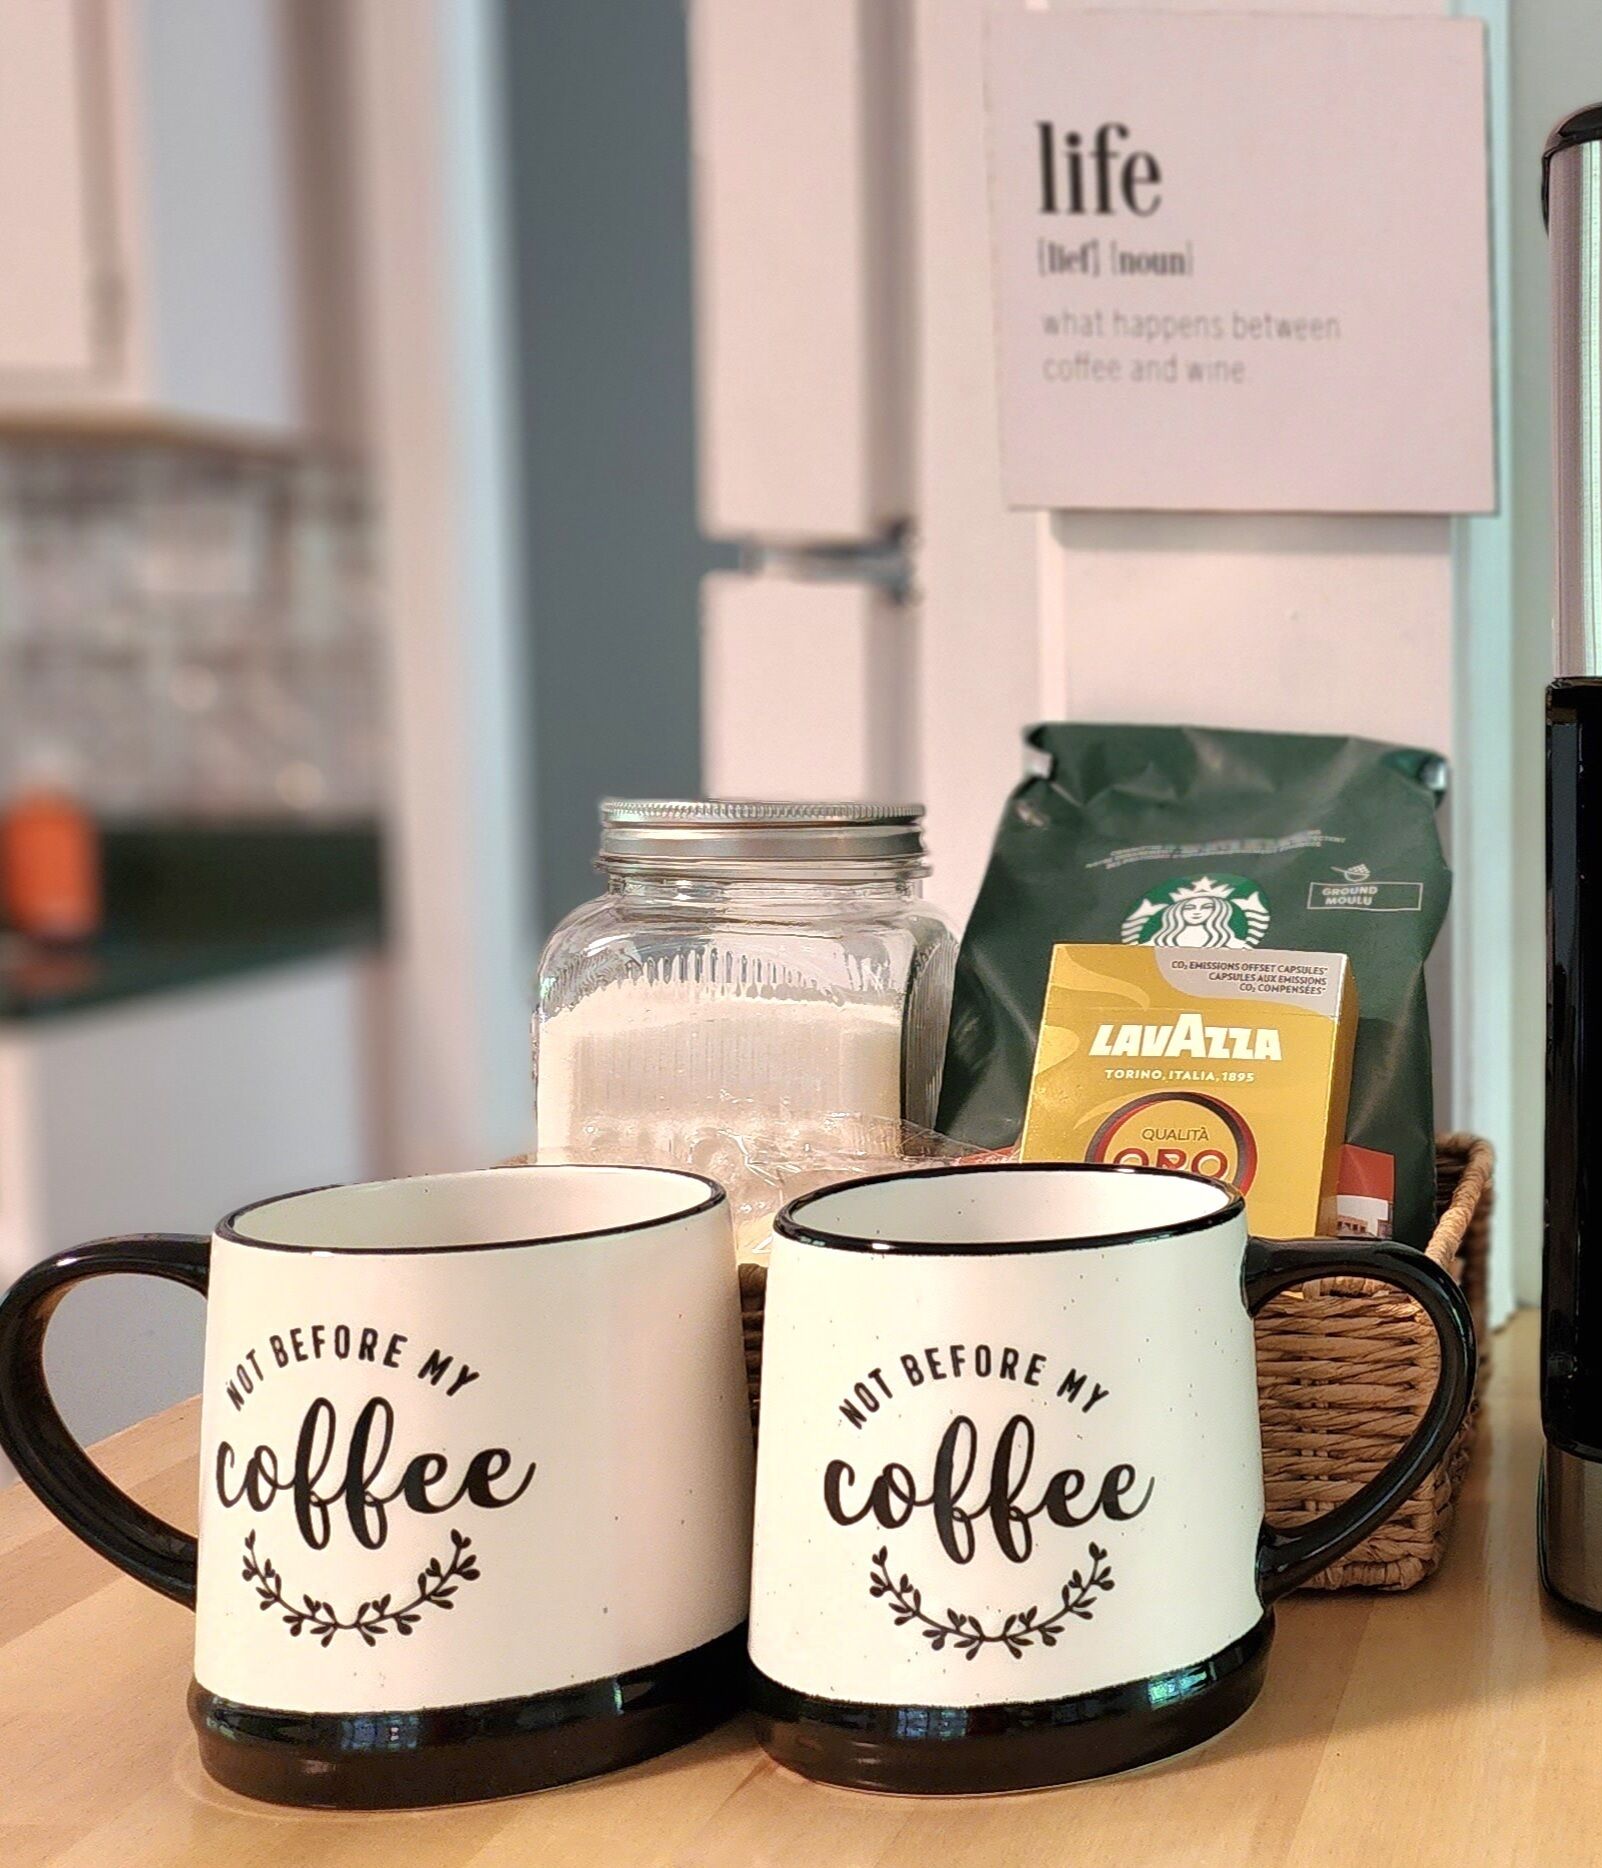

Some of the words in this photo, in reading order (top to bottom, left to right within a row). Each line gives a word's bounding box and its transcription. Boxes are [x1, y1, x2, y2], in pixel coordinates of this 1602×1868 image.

[1036, 120, 1163, 217] life
[1043, 309, 1103, 338] what
[1112, 309, 1225, 344] happens
[1232, 310, 1342, 340] between
[1042, 351, 1123, 383] coffee
[1130, 352, 1179, 384] and
[1185, 356, 1247, 384] wine
[1321, 886, 1379, 896] GROUND
[1324, 896, 1374, 906] MOULU
[1189, 962, 1240, 971] EMISSIONS
[1241, 963, 1276, 972] OFFSET
[1208, 972, 1256, 982] CAPSULES
[1257, 974, 1277, 983] AUX
[1278, 975, 1327, 985] EMISSIONS
[1088, 1013, 1283, 1061] LAVAZZA
[1104, 1069, 1166, 1082] TORINO,
[1168, 1070, 1220, 1083] ITALIA,
[1222, 1071, 1256, 1083] 1895
[1142, 1126, 1210, 1141] QUALITÀ
[225, 1348, 265, 1412] NOT
[268, 1324, 408, 1368] BEFORE
[417, 1348, 481, 1397] MY
[838, 1367, 894, 1430] NOT
[900, 1344, 1047, 1387] BEFORE
[1056, 1368, 1110, 1413] MY
[216, 1396, 537, 1551] coffee
[823, 1414, 1156, 1565] coffee
